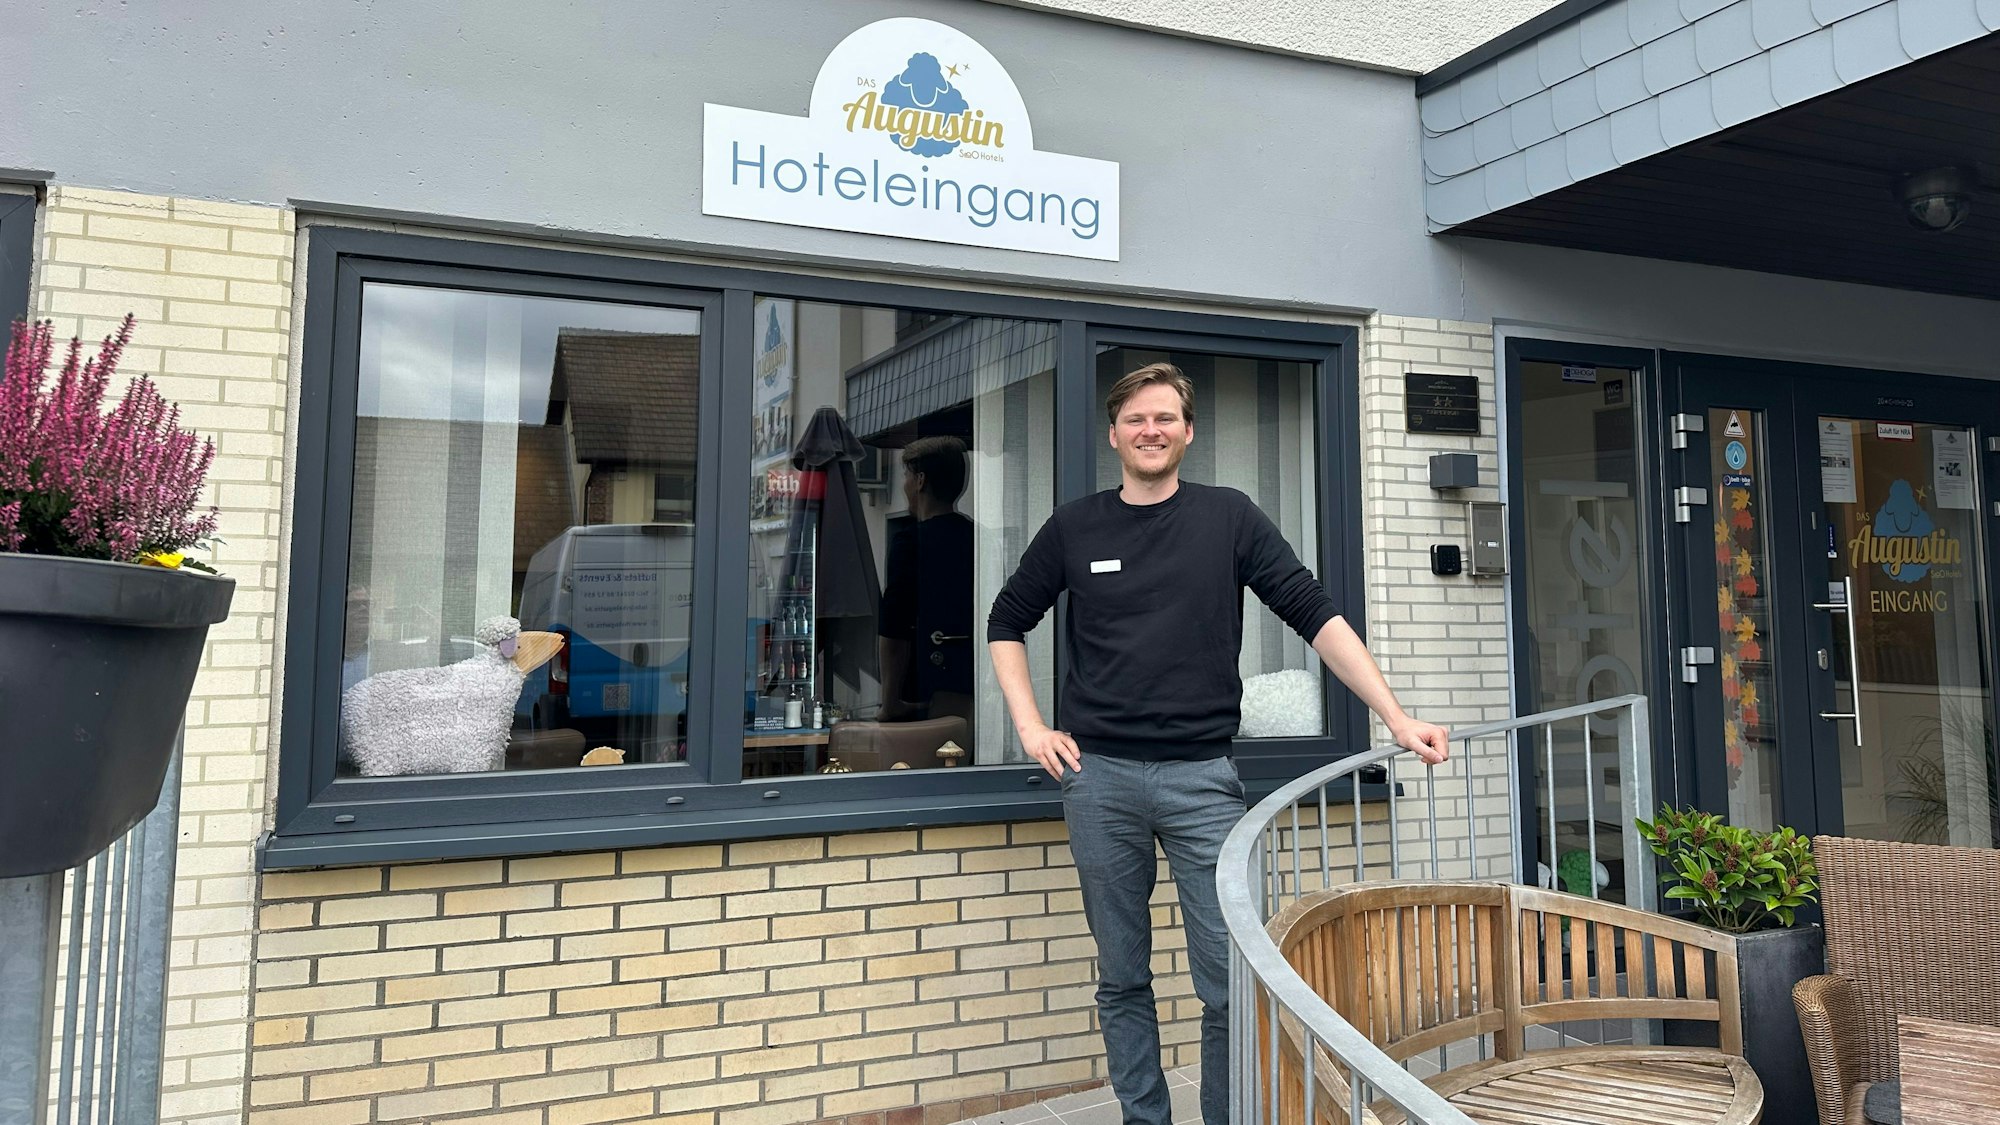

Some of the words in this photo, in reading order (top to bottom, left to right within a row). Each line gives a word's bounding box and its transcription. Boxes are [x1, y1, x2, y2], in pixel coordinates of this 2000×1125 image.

[857, 76, 876, 89] DAS
[842, 91, 1005, 150] Augustin
[981, 151, 1004, 163] Hotels
[731, 140, 1100, 240] Hoteleingang
[1570, 367, 1595, 377] DEHOGA
[1606, 383, 1620, 395] WC
[1856, 511, 1870, 522] DAS
[1848, 524, 1962, 576] Augustin
[1870, 590, 1948, 613] EINGANG
